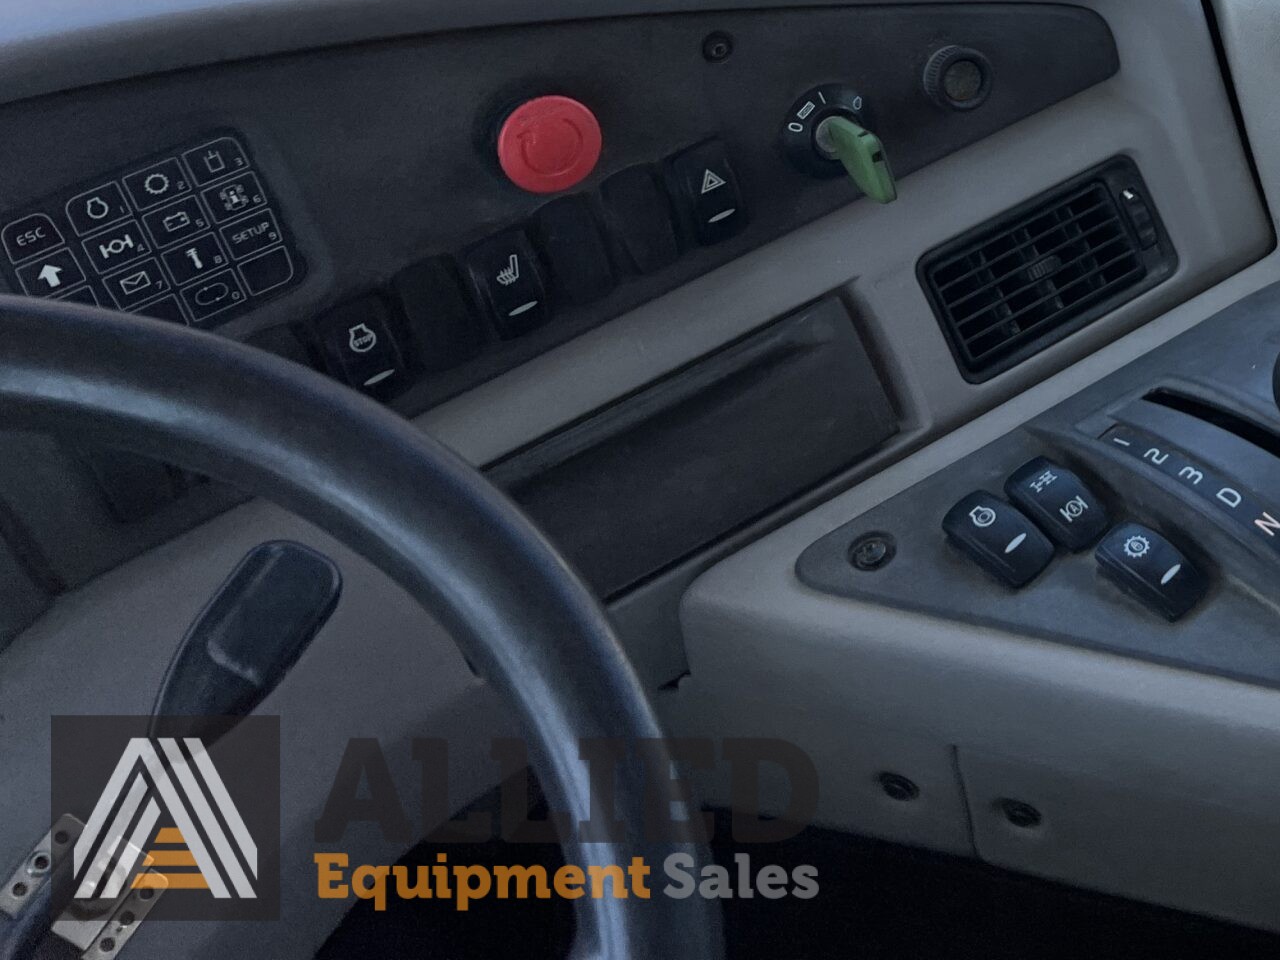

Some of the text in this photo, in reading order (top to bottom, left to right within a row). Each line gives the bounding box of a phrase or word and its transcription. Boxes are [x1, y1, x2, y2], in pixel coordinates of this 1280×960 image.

[235, 157, 244, 167] 3
[176, 181, 184, 190] 2
[252, 194, 261, 203] 6
[196, 218, 204, 227] 5
[16, 226, 46, 246] ESC
[232, 221, 270, 244] SETUP
[137, 243, 144, 252] 4
[1143, 447, 1169, 465] 2
[1178, 466, 1204, 485] 3
[1215, 487, 1242, 508] D
